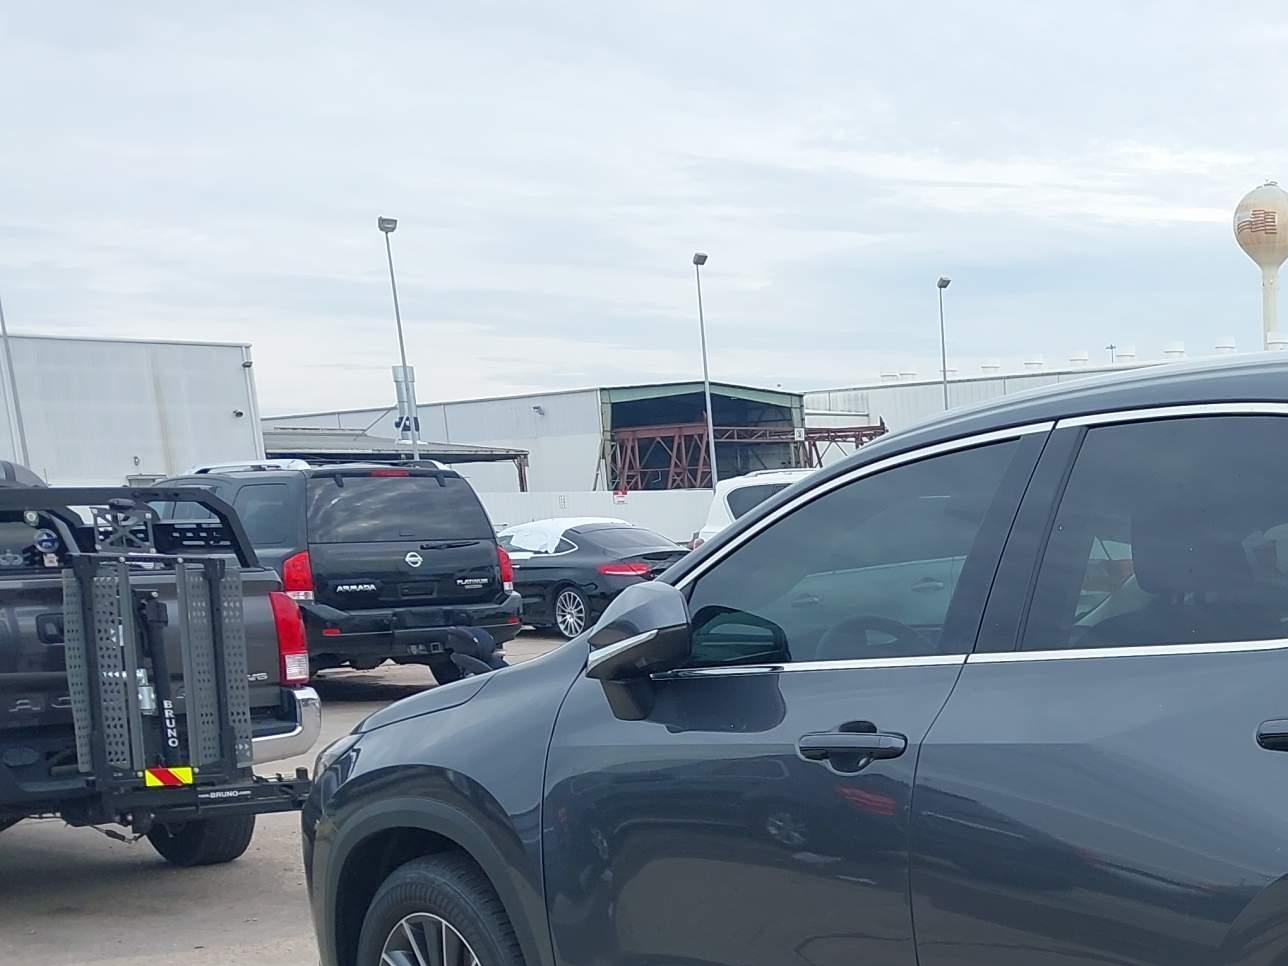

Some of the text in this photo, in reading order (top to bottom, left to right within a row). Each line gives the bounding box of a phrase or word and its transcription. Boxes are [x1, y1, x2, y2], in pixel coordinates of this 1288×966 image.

[336, 583, 377, 593] ARMADA
[163, 700, 179, 748] BRUNO
[209, 790, 240, 799] BRUNO
